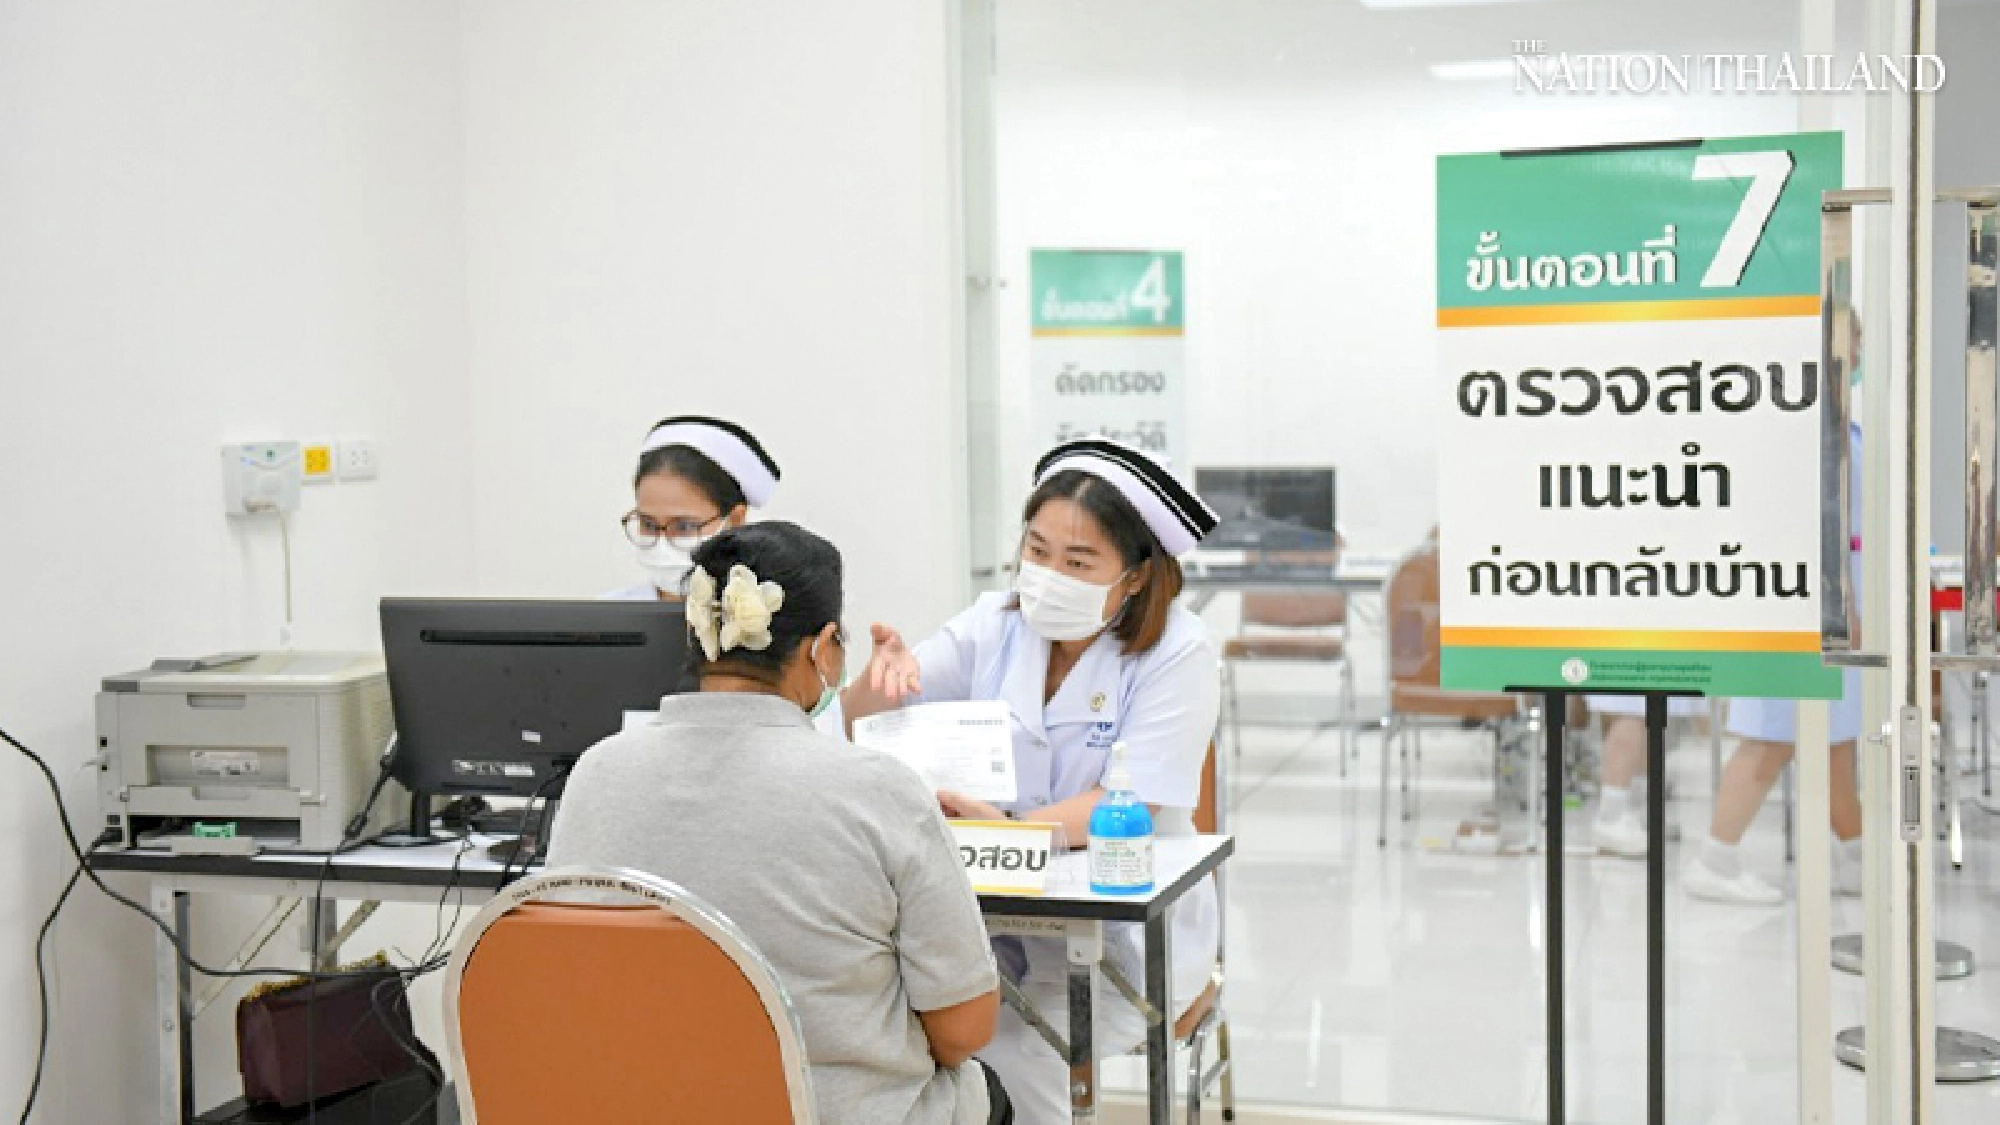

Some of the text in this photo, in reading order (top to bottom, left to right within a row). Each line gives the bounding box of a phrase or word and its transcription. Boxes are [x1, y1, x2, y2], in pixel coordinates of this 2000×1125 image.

[1465, 150, 1797, 291] ขั้นตอนที่ 7
[1131, 256, 1171, 323] 4
[1457, 360, 1818, 417] ตรวจสอบ
[1539, 442, 1731, 508] แนะนำ
[1467, 543, 1811, 599] ก่อนกลับบ้าน
